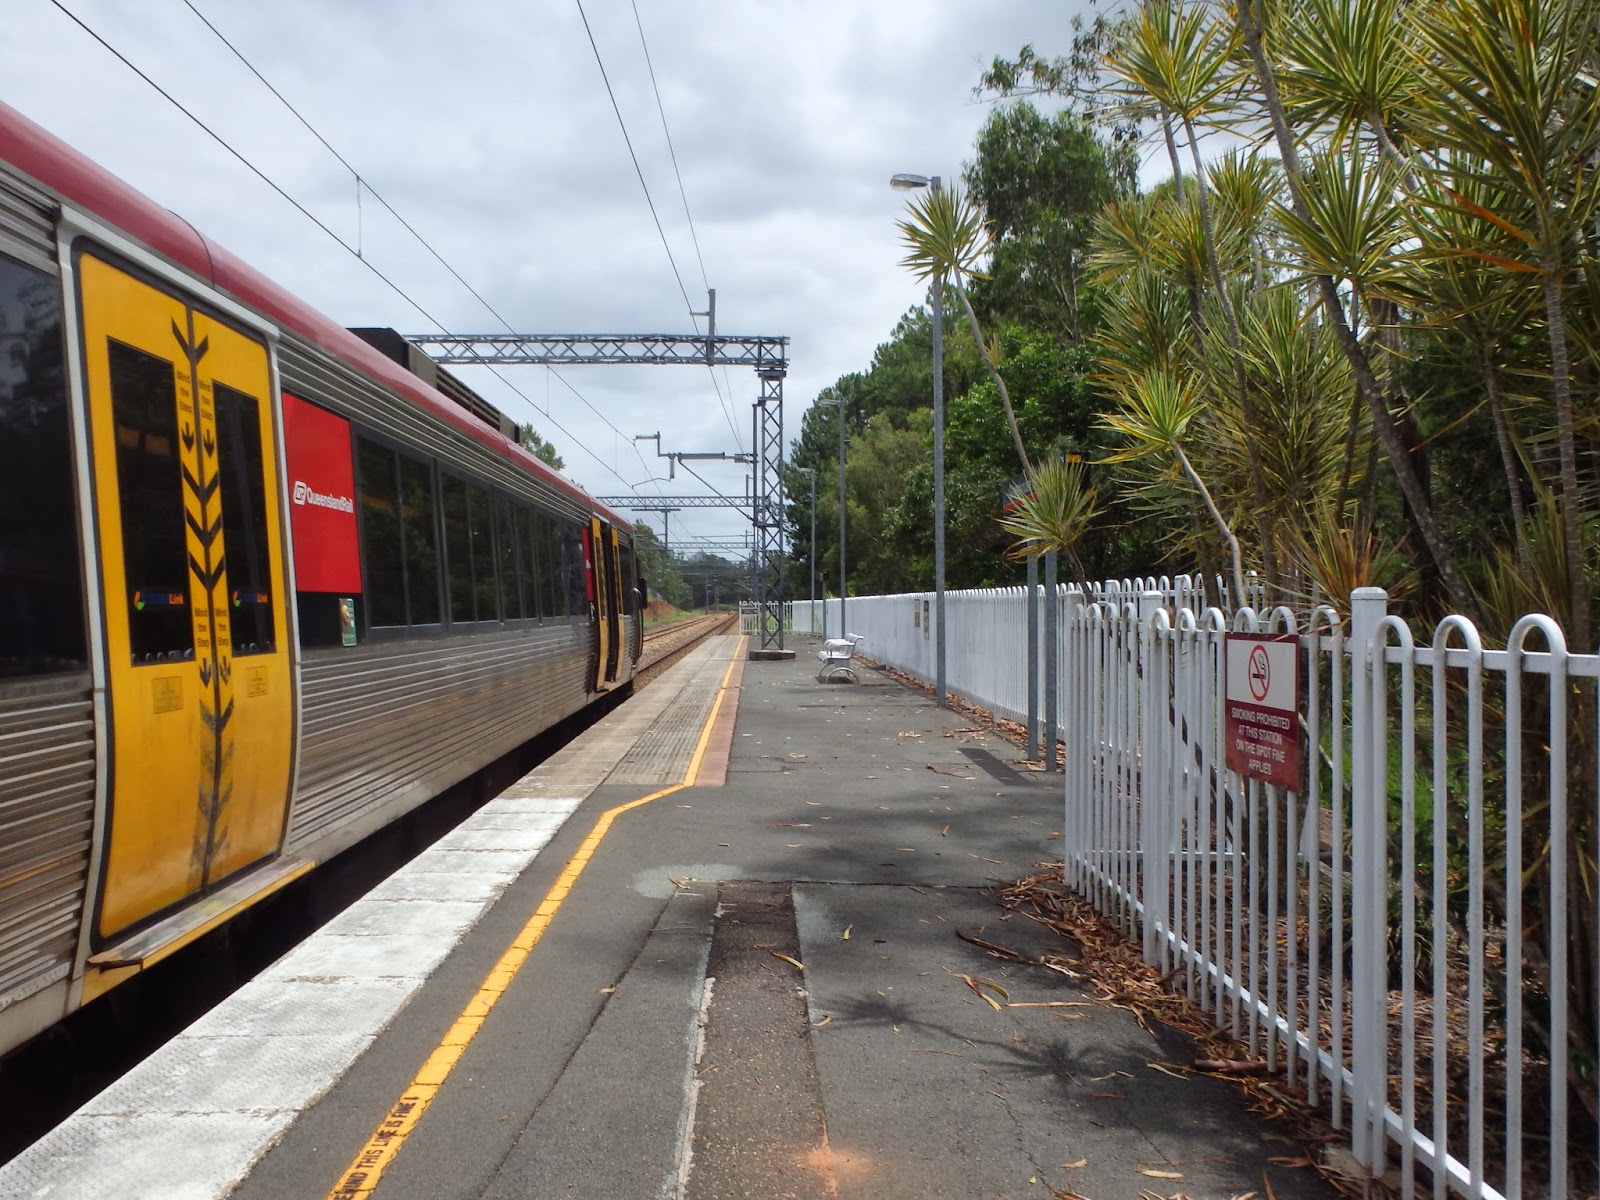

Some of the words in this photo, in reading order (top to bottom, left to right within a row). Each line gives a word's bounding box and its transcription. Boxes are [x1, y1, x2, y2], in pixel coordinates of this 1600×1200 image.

[1231, 706, 1256, 723] SMOKING
[1256, 711, 1290, 730] PROHIBITED
[1238, 724, 1245, 736] AT
[1245, 725, 1258, 739] THIS
[1258, 728, 1283, 746] STATION
[1235, 738, 1245, 751] ON
[1244, 741, 1256, 755] THE
[1255, 744, 1272, 759] SPOT
[1271, 748, 1286, 763] FINE
[1248, 758, 1272, 775] APPLIES
[391, 1102, 416, 1118] FINE
[384, 1120, 404, 1128] IS
[371, 1129, 398, 1147] LINE
[355, 1149, 384, 1169] THIS
